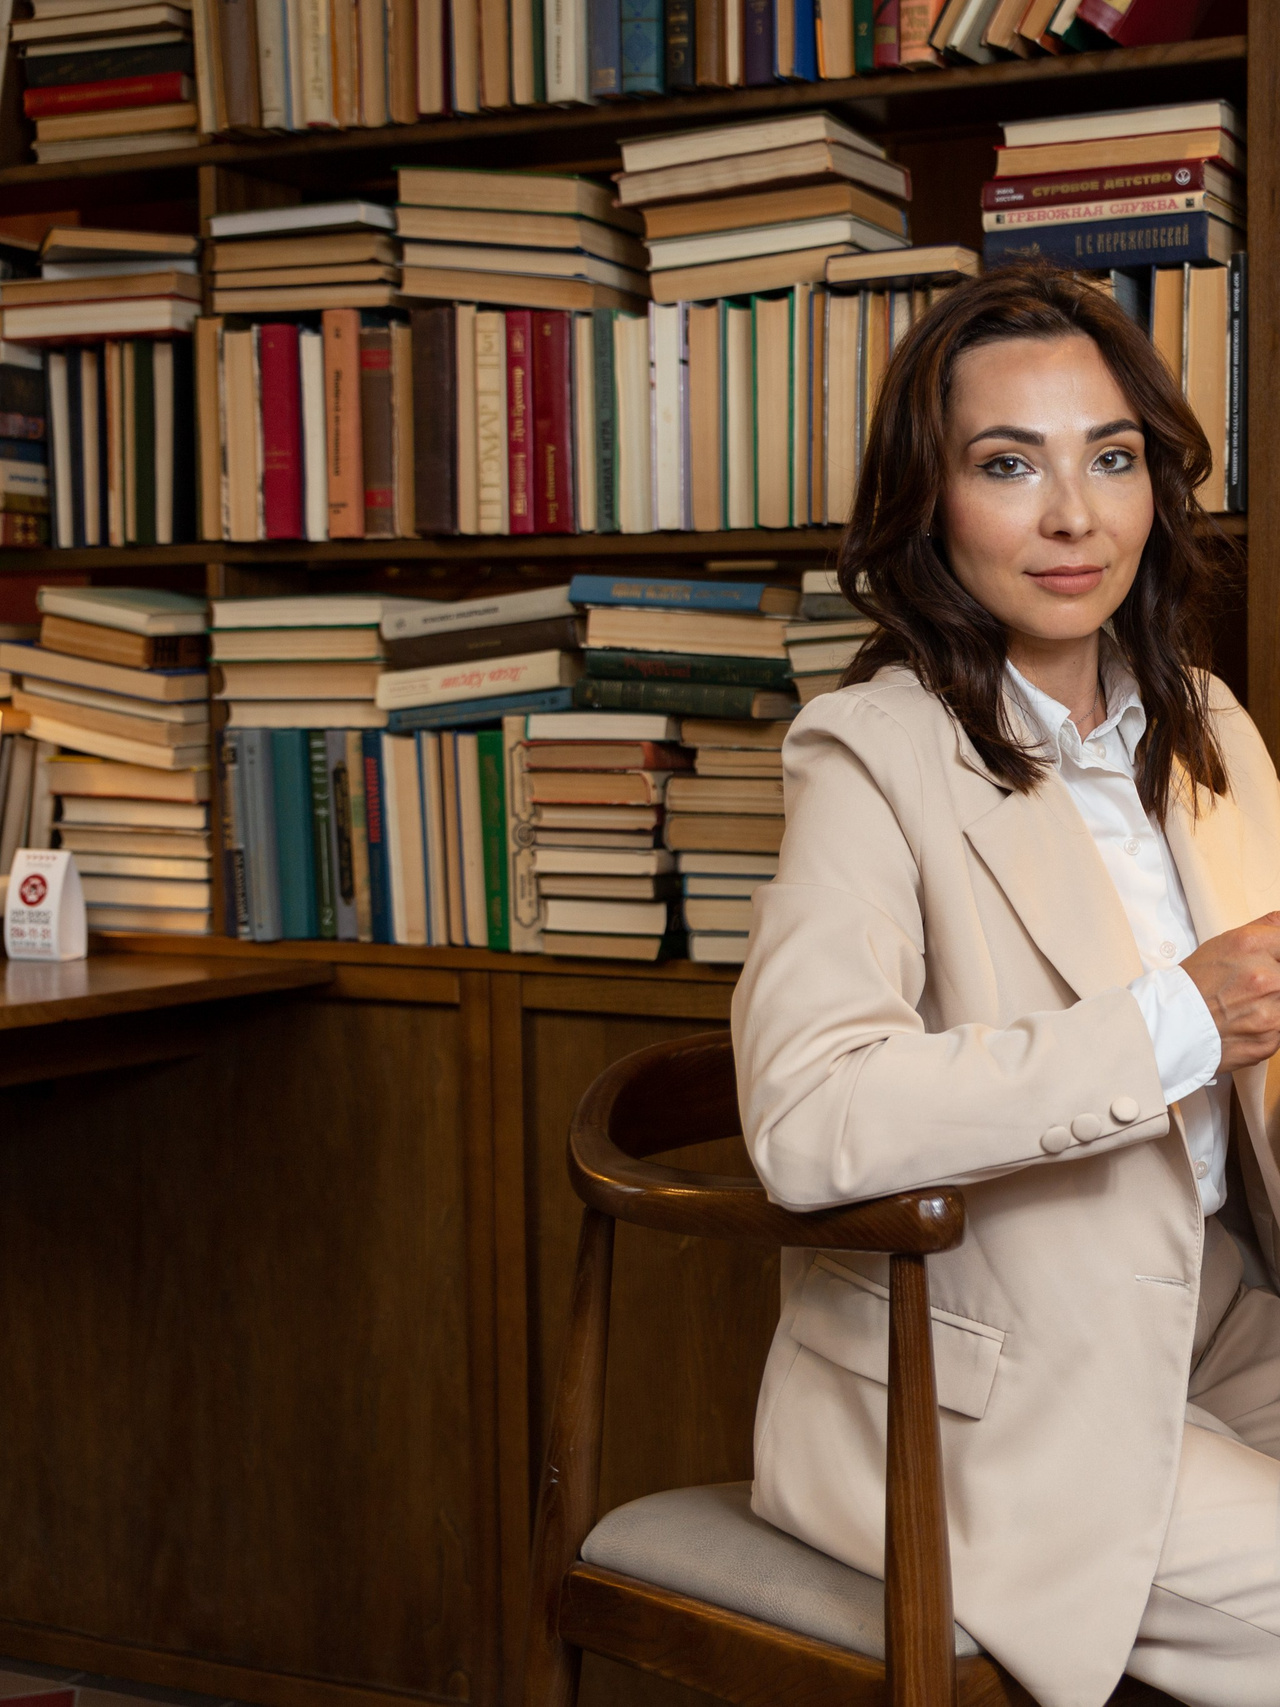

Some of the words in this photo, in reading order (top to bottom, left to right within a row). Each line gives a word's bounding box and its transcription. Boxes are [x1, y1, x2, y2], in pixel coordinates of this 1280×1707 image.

[1032, 181, 1100, 197] СУРОВОЕ
[1104, 172, 1172, 190] ДЕТСТВО
[1007, 205, 1104, 224] ТРЕВОЖНАЯ
[1109, 199, 1179, 215] СЛУЖБА
